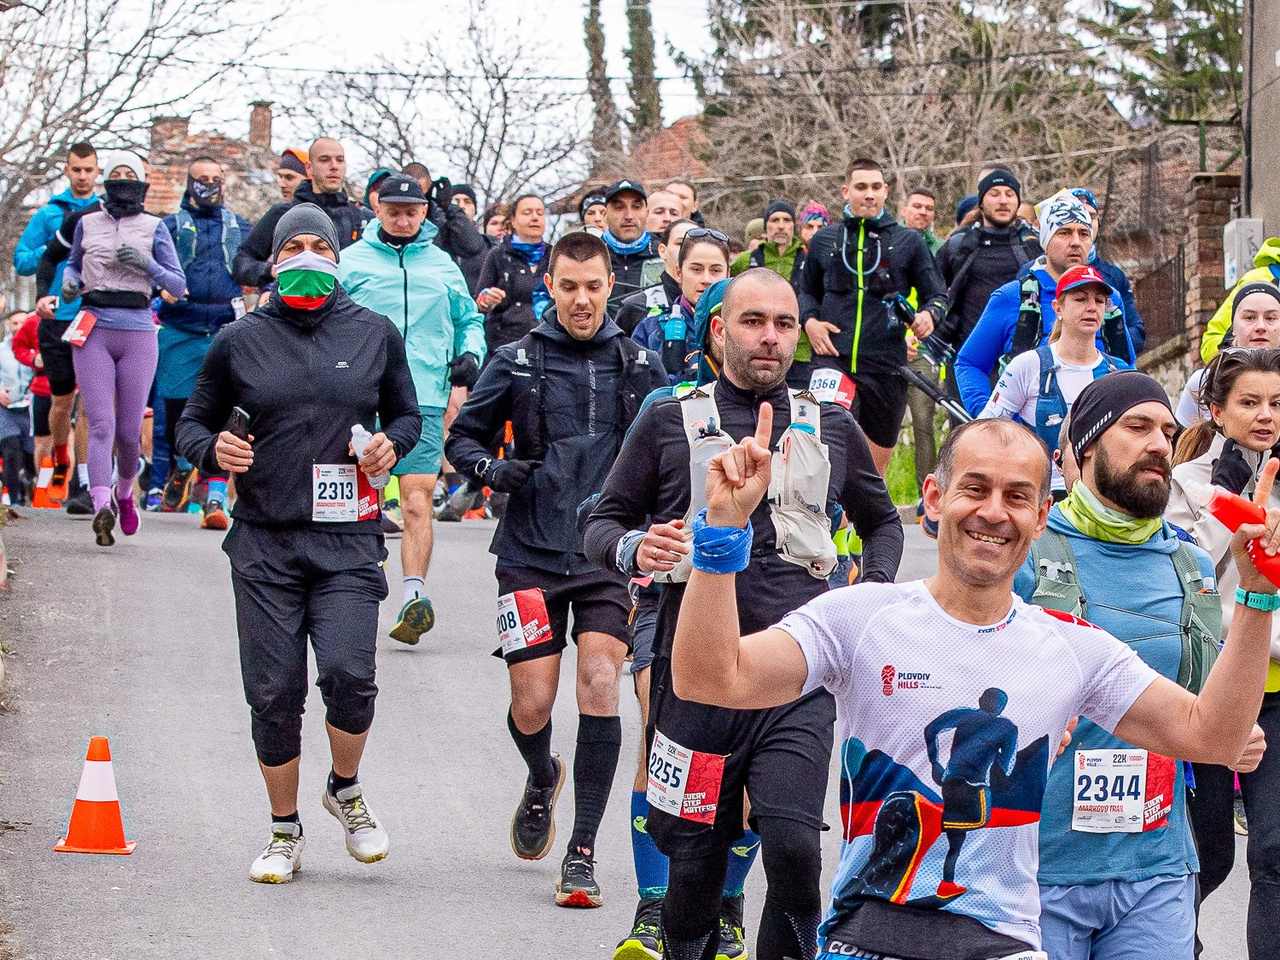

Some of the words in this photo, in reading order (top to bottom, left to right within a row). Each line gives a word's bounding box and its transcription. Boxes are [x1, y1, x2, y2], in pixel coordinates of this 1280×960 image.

[811, 378, 837, 391] 2368
[317, 481, 354, 500] 2313
[897, 672, 931, 681] PLOVDIV
[897, 681, 919, 690] HILLS
[1112, 753, 1128, 764] 22K
[649, 751, 683, 789] 2255
[1077, 774, 1142, 802] 2344
[683, 799, 702, 808] STEP
